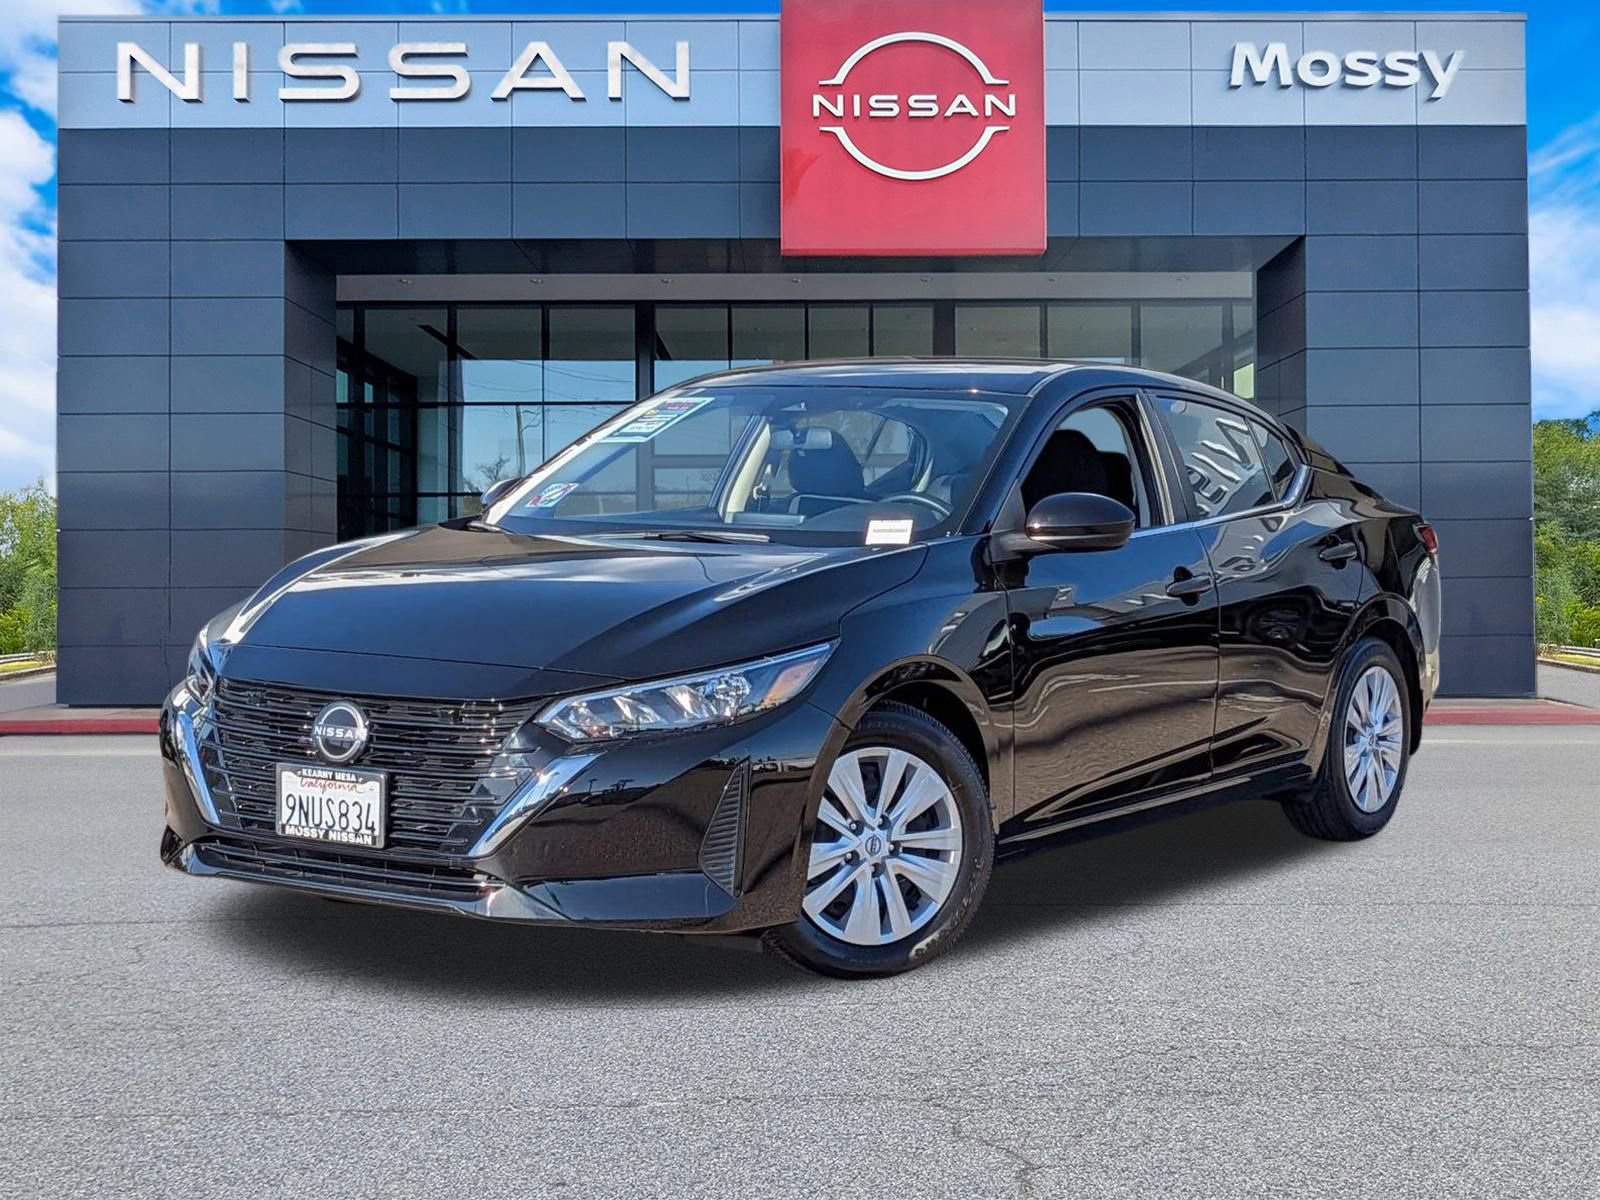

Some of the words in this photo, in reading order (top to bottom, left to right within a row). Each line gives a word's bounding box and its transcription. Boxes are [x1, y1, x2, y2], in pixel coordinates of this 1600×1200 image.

[116, 41, 691, 102] NISSAN
[1229, 41, 1465, 101] Mossy
[812, 92, 1017, 118] NISSAN
[314, 726, 367, 741] NISSAN
[302, 768, 333, 780] KEARNY
[335, 772, 356, 783] MESA
[286, 794, 375, 833] 9NUS834
[285, 825, 326, 839] MOSSY
[328, 831, 372, 845] NISSAN
